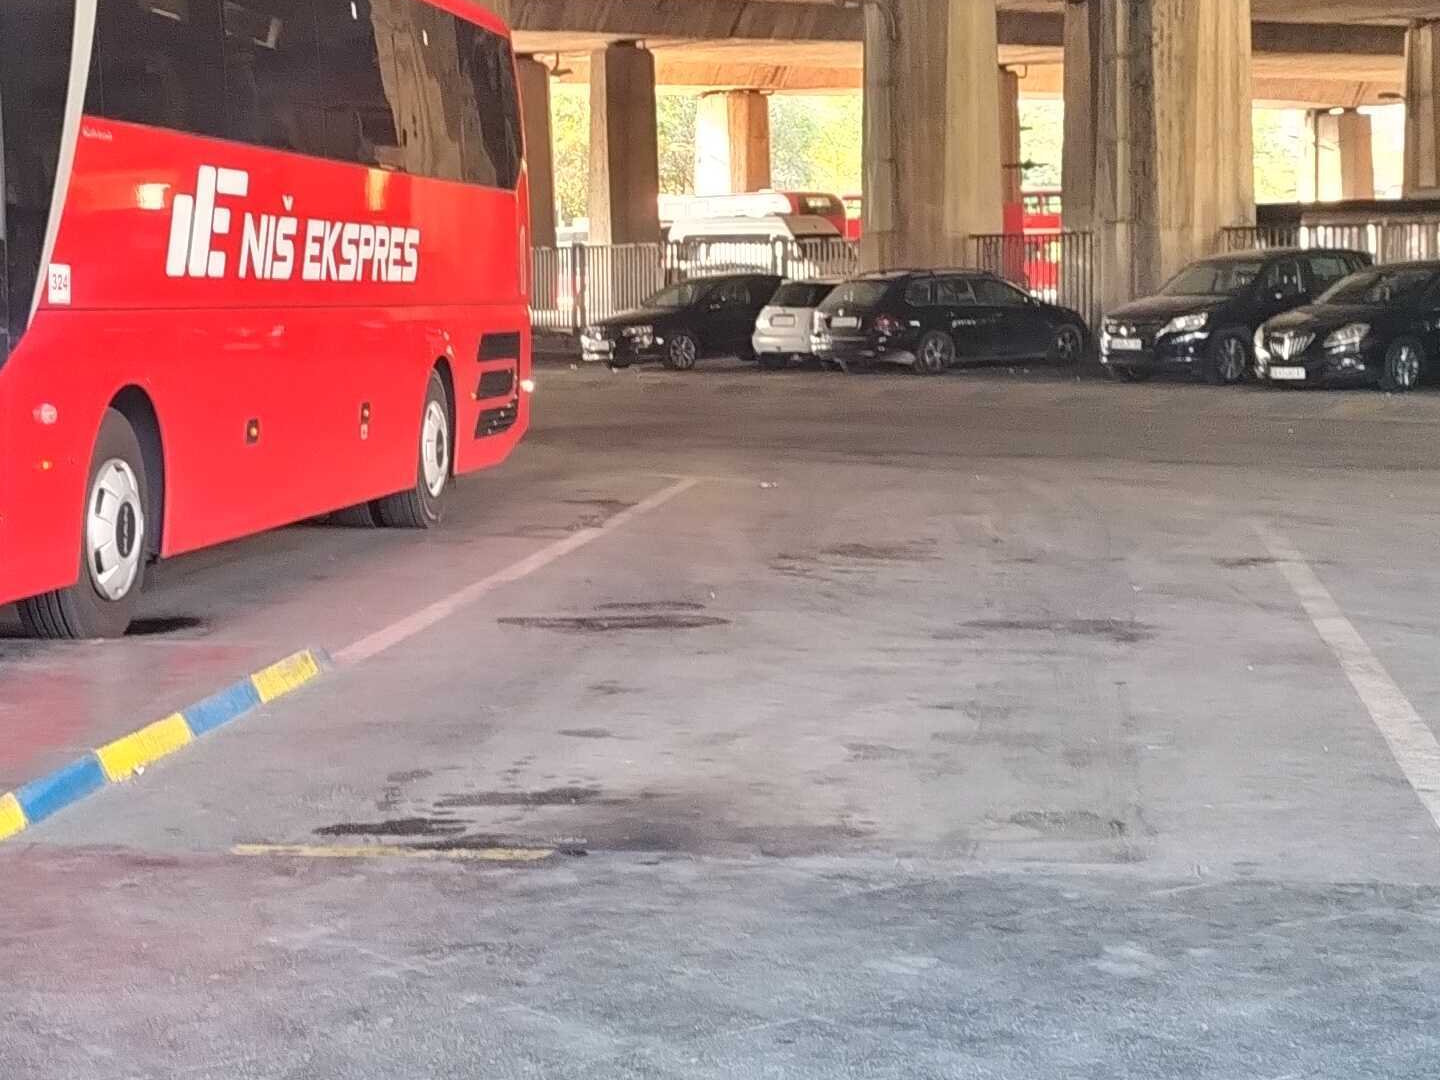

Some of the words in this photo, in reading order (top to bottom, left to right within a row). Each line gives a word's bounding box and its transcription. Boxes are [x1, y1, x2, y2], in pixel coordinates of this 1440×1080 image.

[238, 195, 298, 281] NIŠ
[302, 218, 420, 282] EKSPRES
[51, 273, 68, 290] 324
